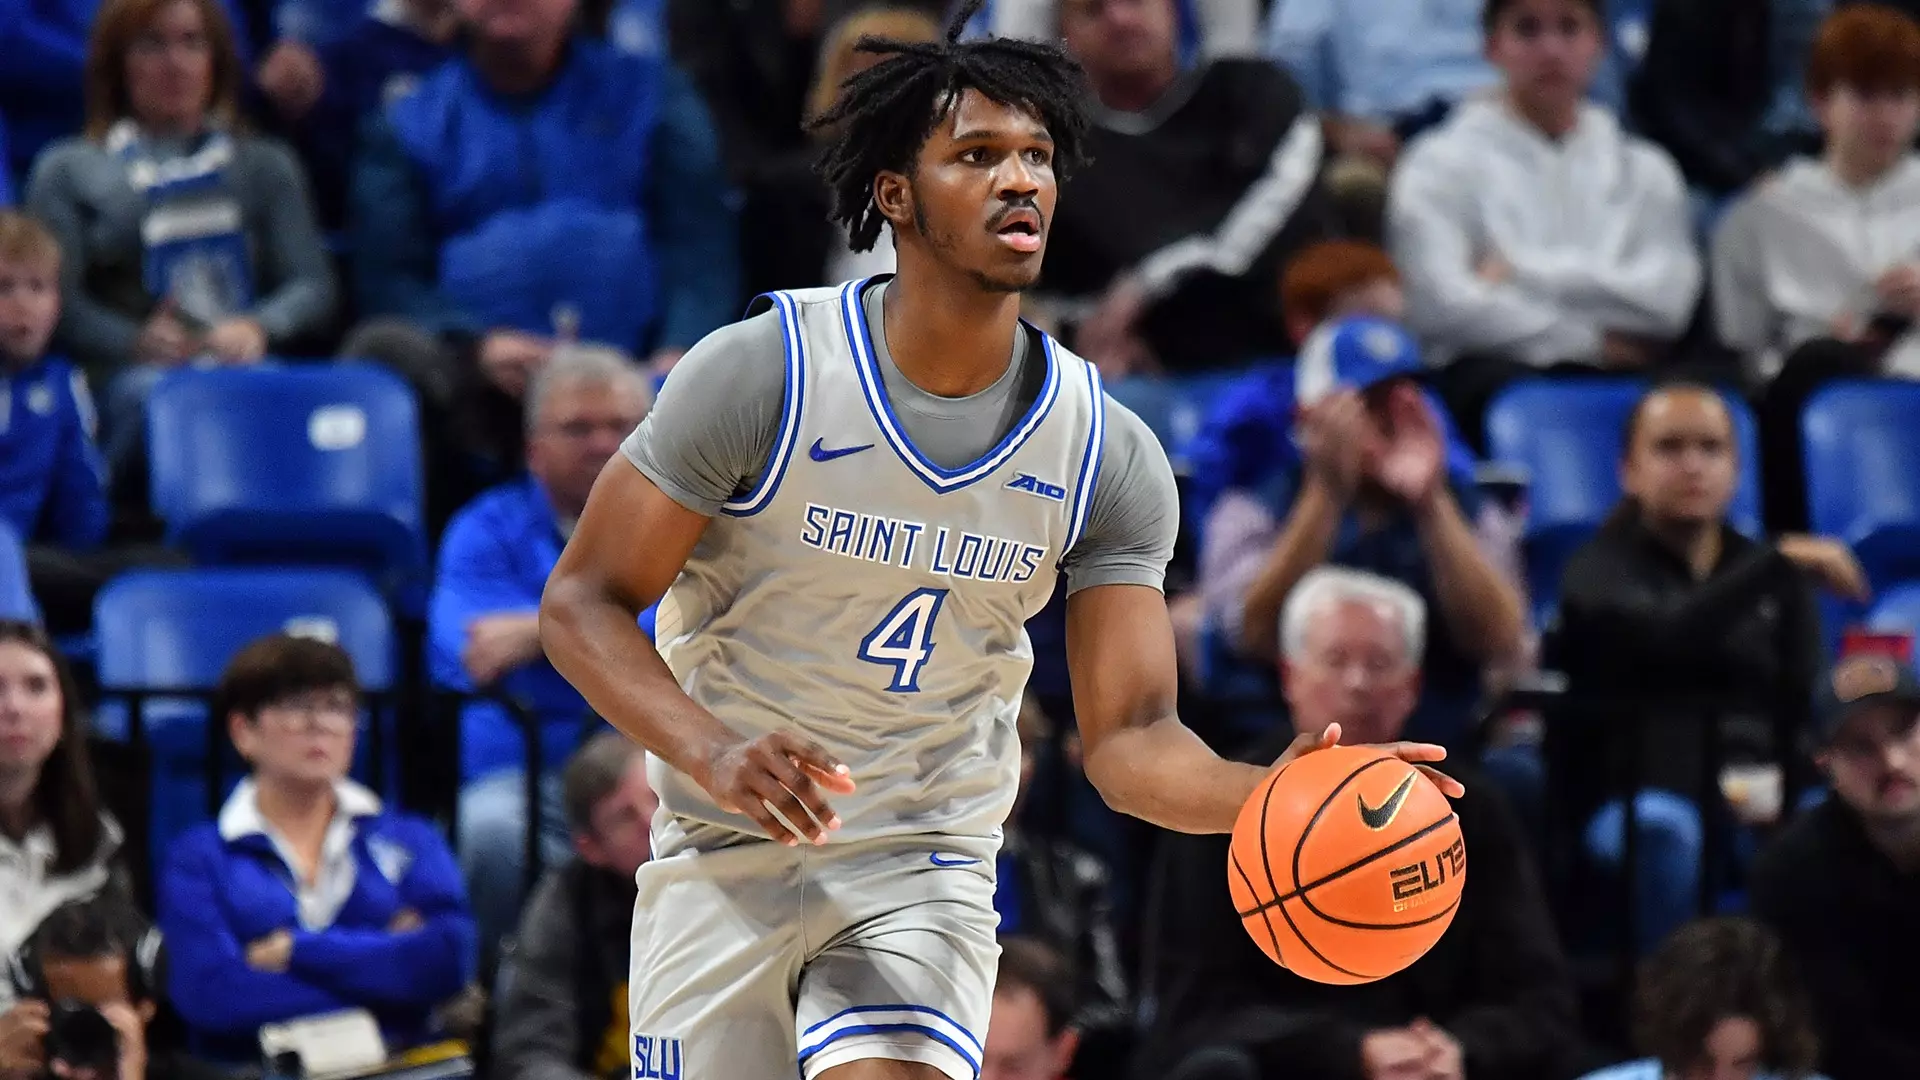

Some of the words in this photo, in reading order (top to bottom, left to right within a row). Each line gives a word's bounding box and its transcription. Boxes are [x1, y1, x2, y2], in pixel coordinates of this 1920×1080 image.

[1006, 473, 1066, 500] A10
[801, 502, 925, 568] SAINT
[930, 527, 1049, 582] LOUIS
[857, 587, 950, 692] 4
[1389, 837, 1465, 900] ELITE
[634, 1034, 681, 1080] SLU
